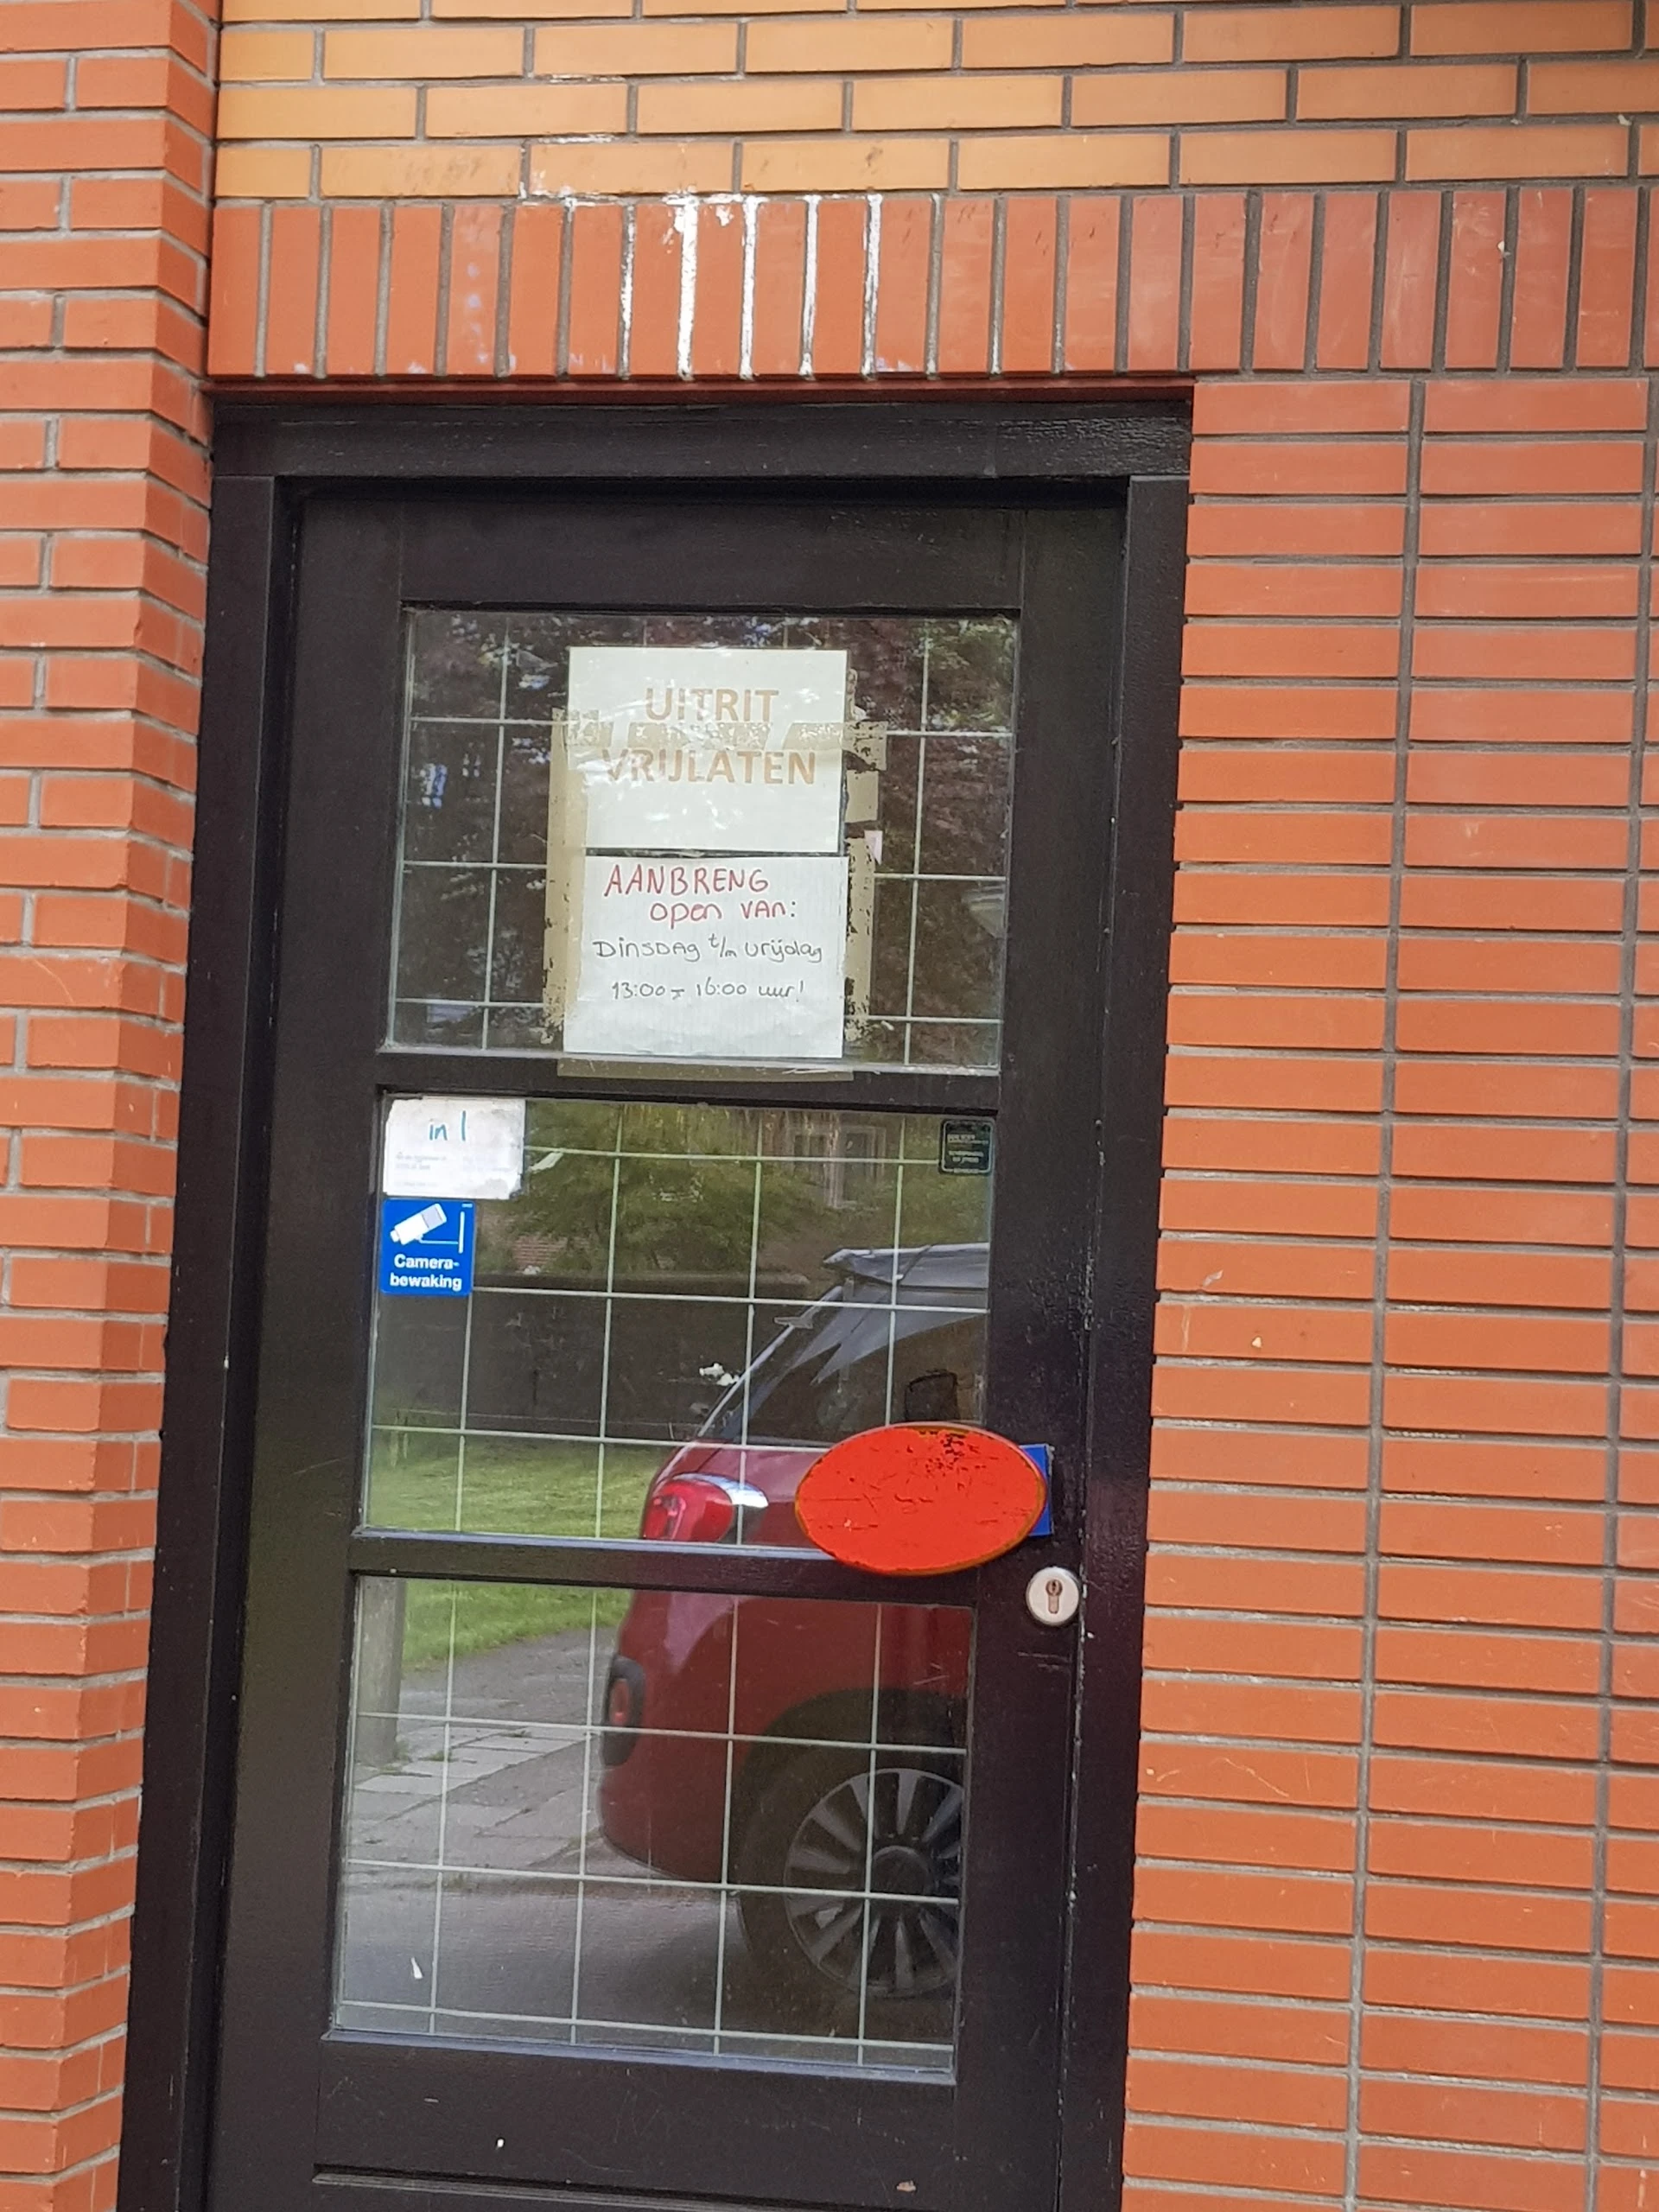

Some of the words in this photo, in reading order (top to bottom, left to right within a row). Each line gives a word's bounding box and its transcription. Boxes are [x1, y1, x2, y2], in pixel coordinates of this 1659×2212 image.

[645, 688, 779, 722] UITRIT
[601, 748, 817, 785] VRIJLATEN
[604, 864, 769, 897] AANBRENG
[650, 902, 723, 931] open
[709, 933, 737, 958] t/m
[696, 976, 747, 996] 16:00
[393, 1253, 461, 1270] Camera-
[389, 1272, 463, 1292] bewaking
